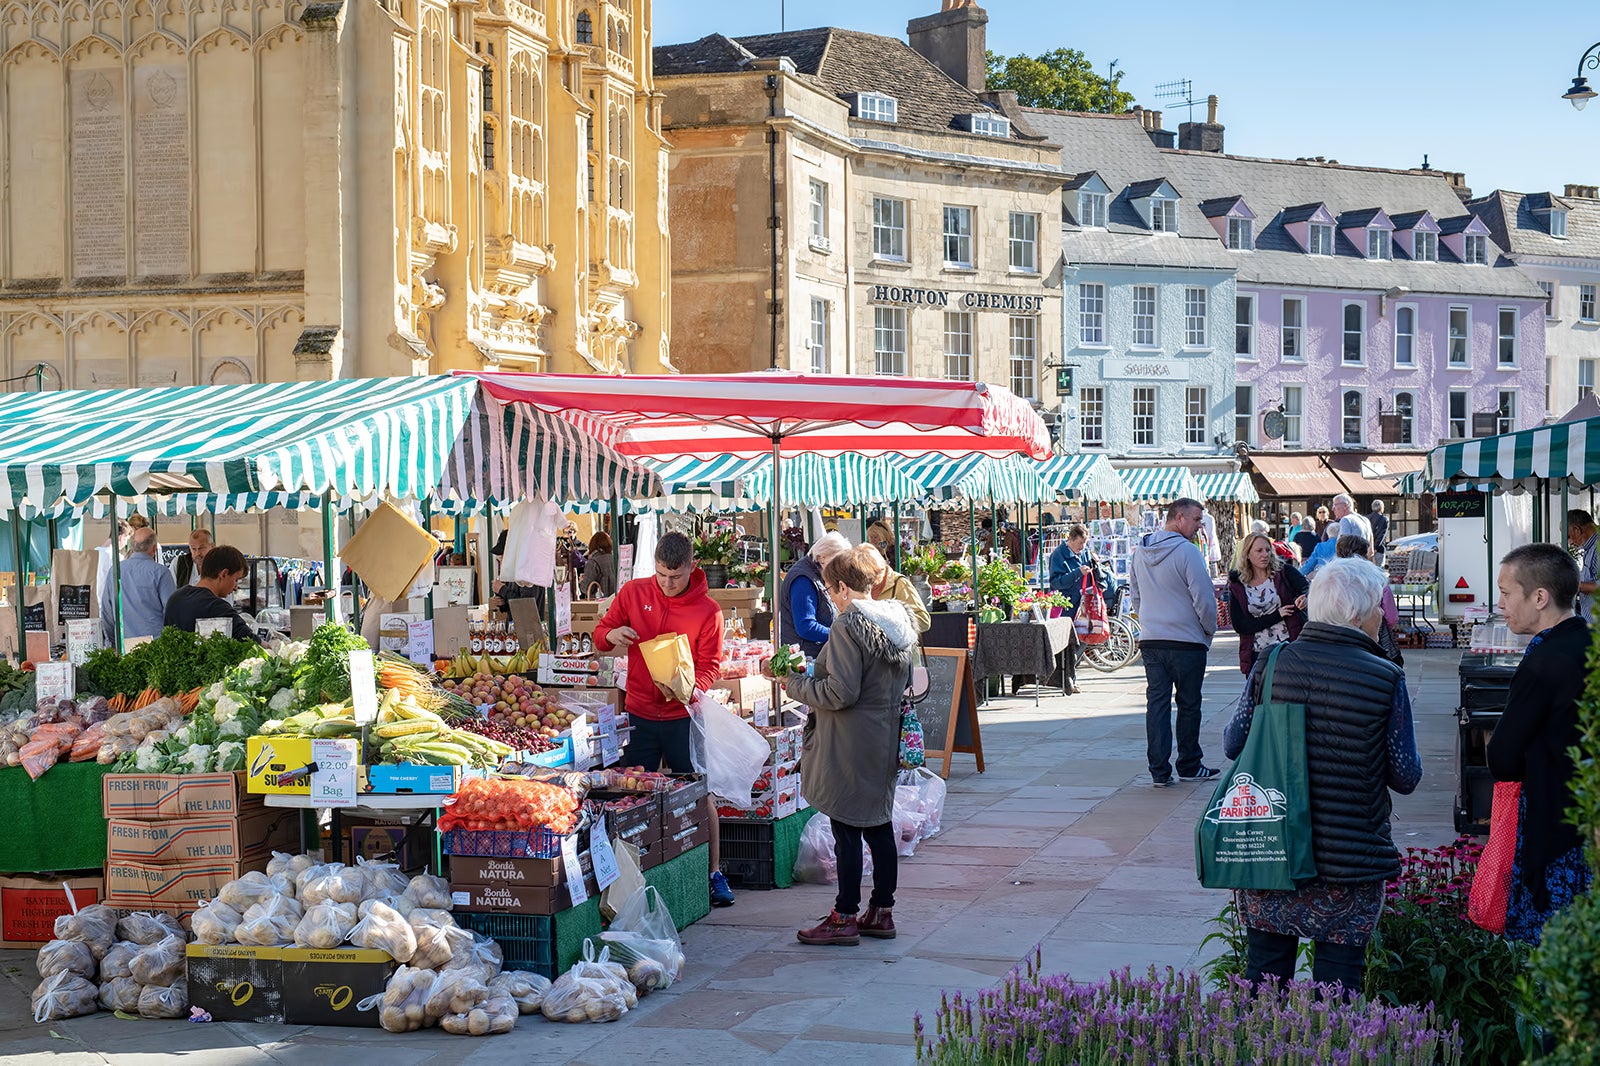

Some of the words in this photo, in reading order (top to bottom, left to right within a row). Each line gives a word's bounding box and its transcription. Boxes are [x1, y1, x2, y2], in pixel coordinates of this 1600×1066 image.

[875, 285, 949, 306] HORTON
[965, 292, 1044, 311] CHEMIST
[1123, 363, 1171, 377] SAHARA
[1267, 471, 1331, 481] GOLDSMITHS
[1440, 500, 1480, 510] WRAPS
[320, 761, 348, 770] £2.00
[328, 773, 337, 783] A
[109, 780, 140, 791] FRESH
[143, 780, 169, 791] FROM
[1237, 785, 1251, 795] THE
[322, 786, 343, 797] Bag
[184, 800, 203, 811] THE
[206, 799, 232, 811] LAND
[1244, 805, 1269, 817] SHOP
[111, 826, 140, 837] FRESH
[186, 846, 205, 857] THE
[208, 844, 233, 856] LAND
[487, 860, 515, 870] Bontà
[110, 867, 139, 879] FRESH
[140, 870, 165, 882] FROM
[479, 869, 525, 880] NATURA
[186, 889, 206, 900] THE
[484, 887, 511, 897] Bontà
[476, 896, 522, 907] NATURA
[12, 920, 38, 929] FRESH
[335, 953, 357, 961] BAKING
